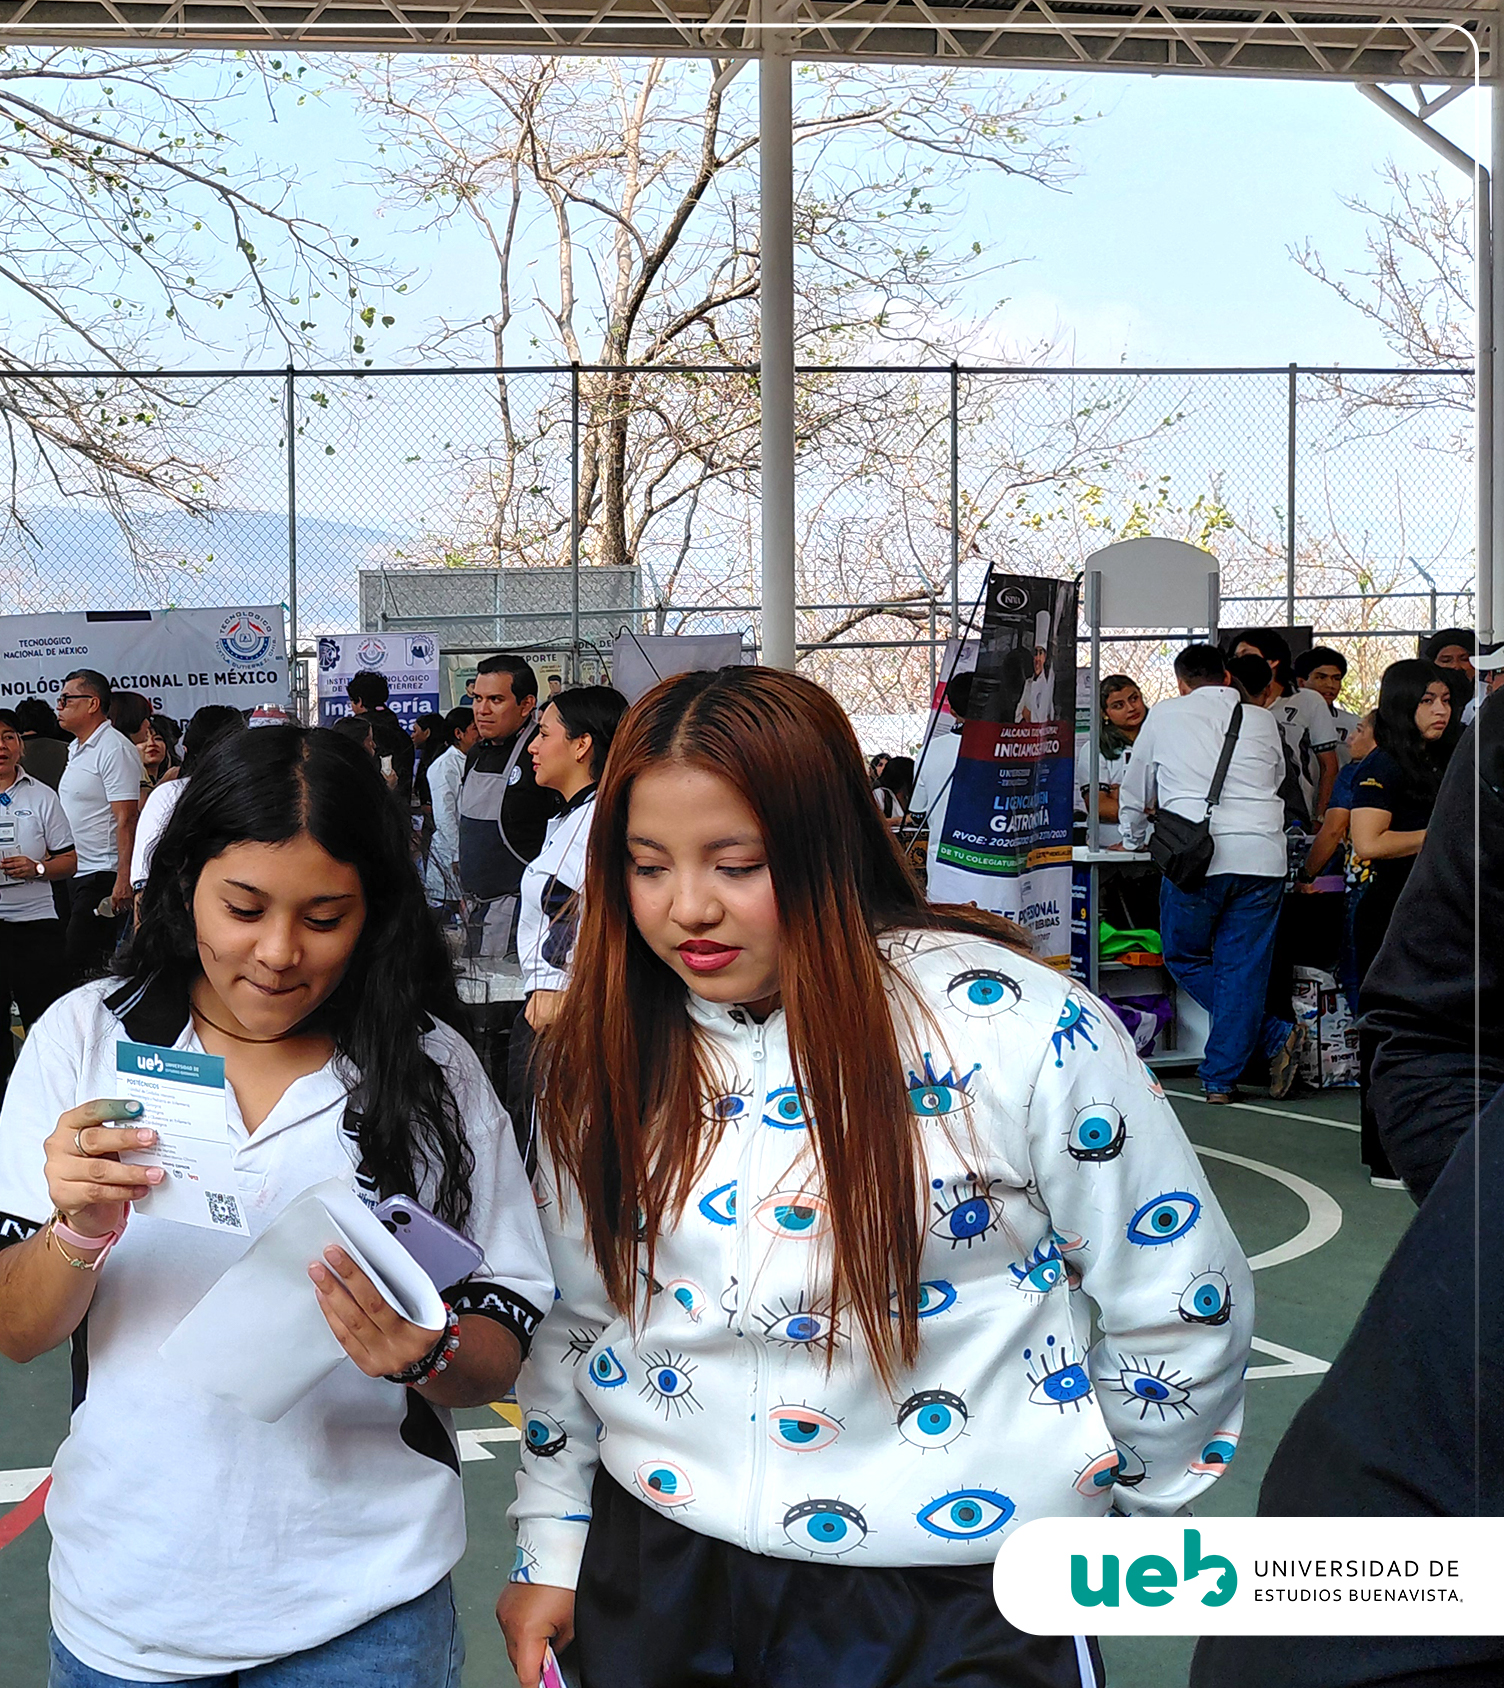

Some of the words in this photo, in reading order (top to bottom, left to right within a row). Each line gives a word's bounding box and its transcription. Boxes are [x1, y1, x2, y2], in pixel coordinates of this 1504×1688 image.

[3, 649, 43, 660] NACIONAL
[46, 648, 56, 656] DE
[523, 653, 557, 663] PORTE
[110, 674, 183, 690] ACIONAL
[188, 673, 209, 686] DE
[214, 669, 278, 686] MÉXICO
[325, 697, 433, 717] Ingería
[1284, 706, 1298, 722] 7
[952, 830, 987, 845] RVOE:
[940, 847, 951, 856] DE
[954, 850, 964, 859] TU
[137, 1053, 164, 1072] ueb
